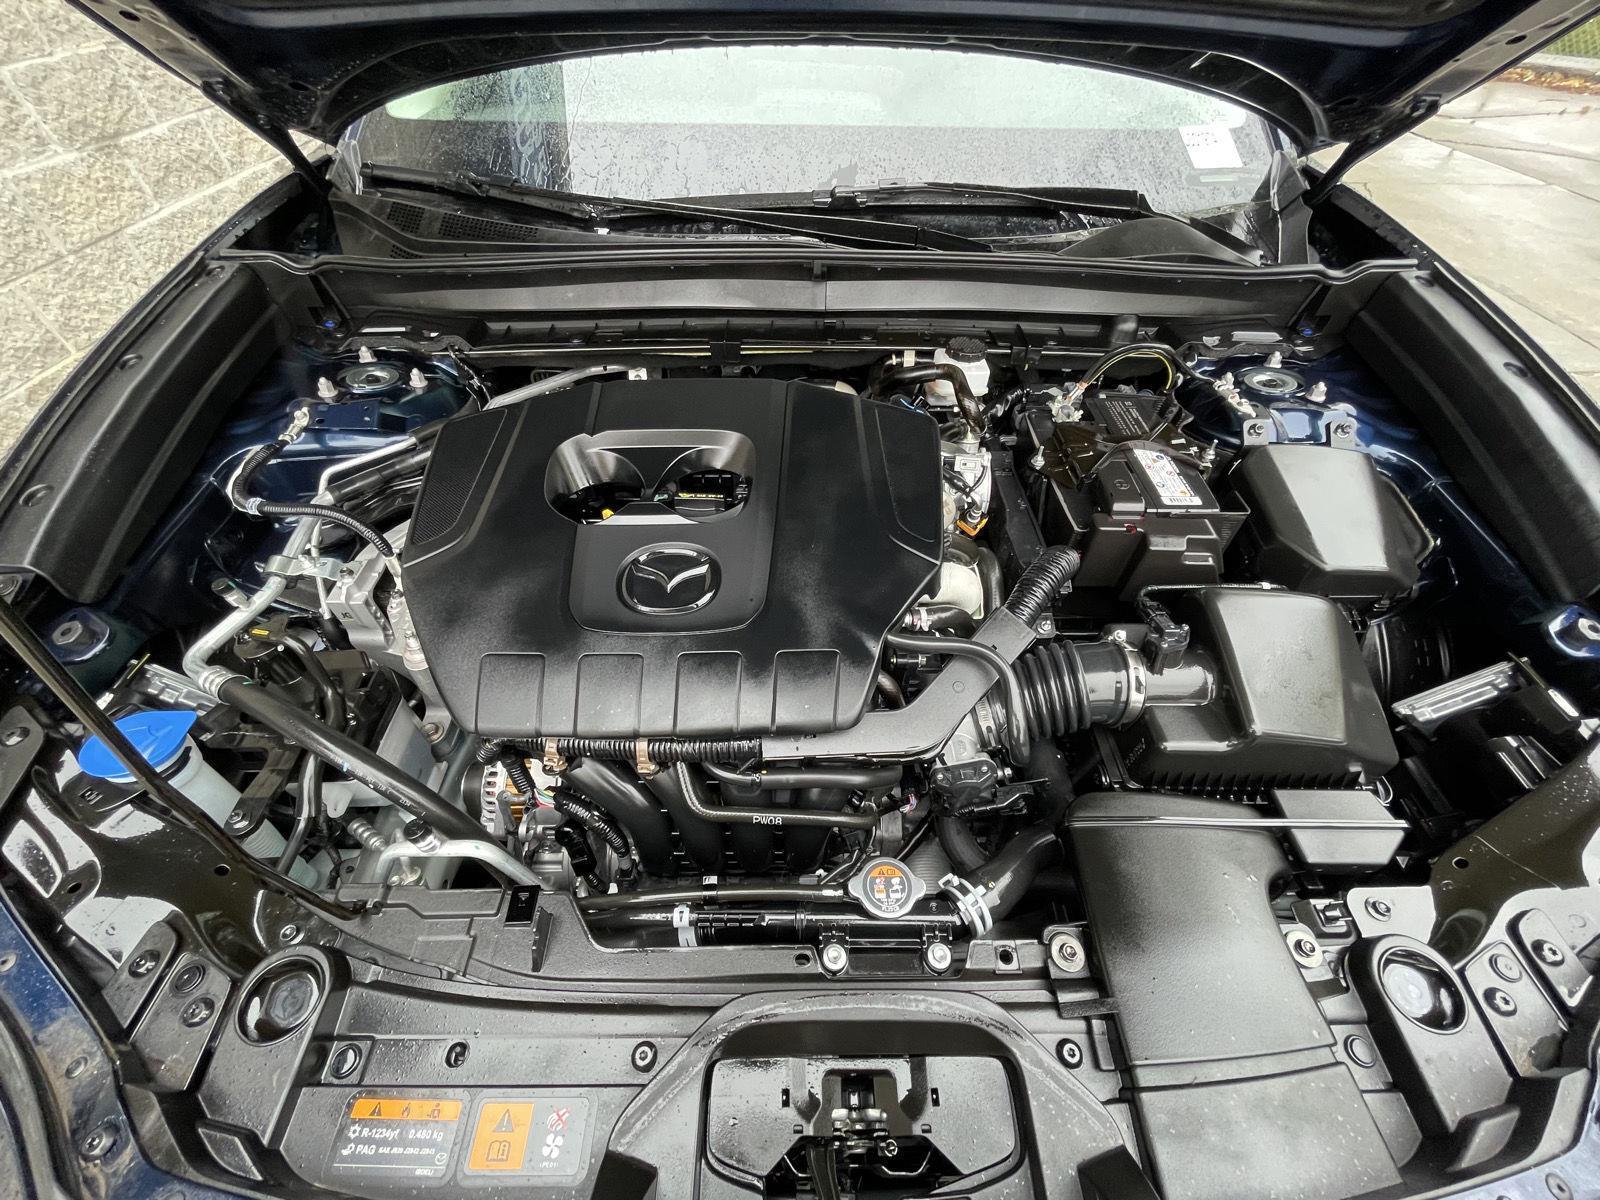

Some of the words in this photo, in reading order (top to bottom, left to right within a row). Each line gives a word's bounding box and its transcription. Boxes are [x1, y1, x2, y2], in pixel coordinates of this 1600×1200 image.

[360, 1127, 401, 1141] R-1234yf
[432, 1129, 444, 1142] kg
[355, 1144, 377, 1155] PAG
